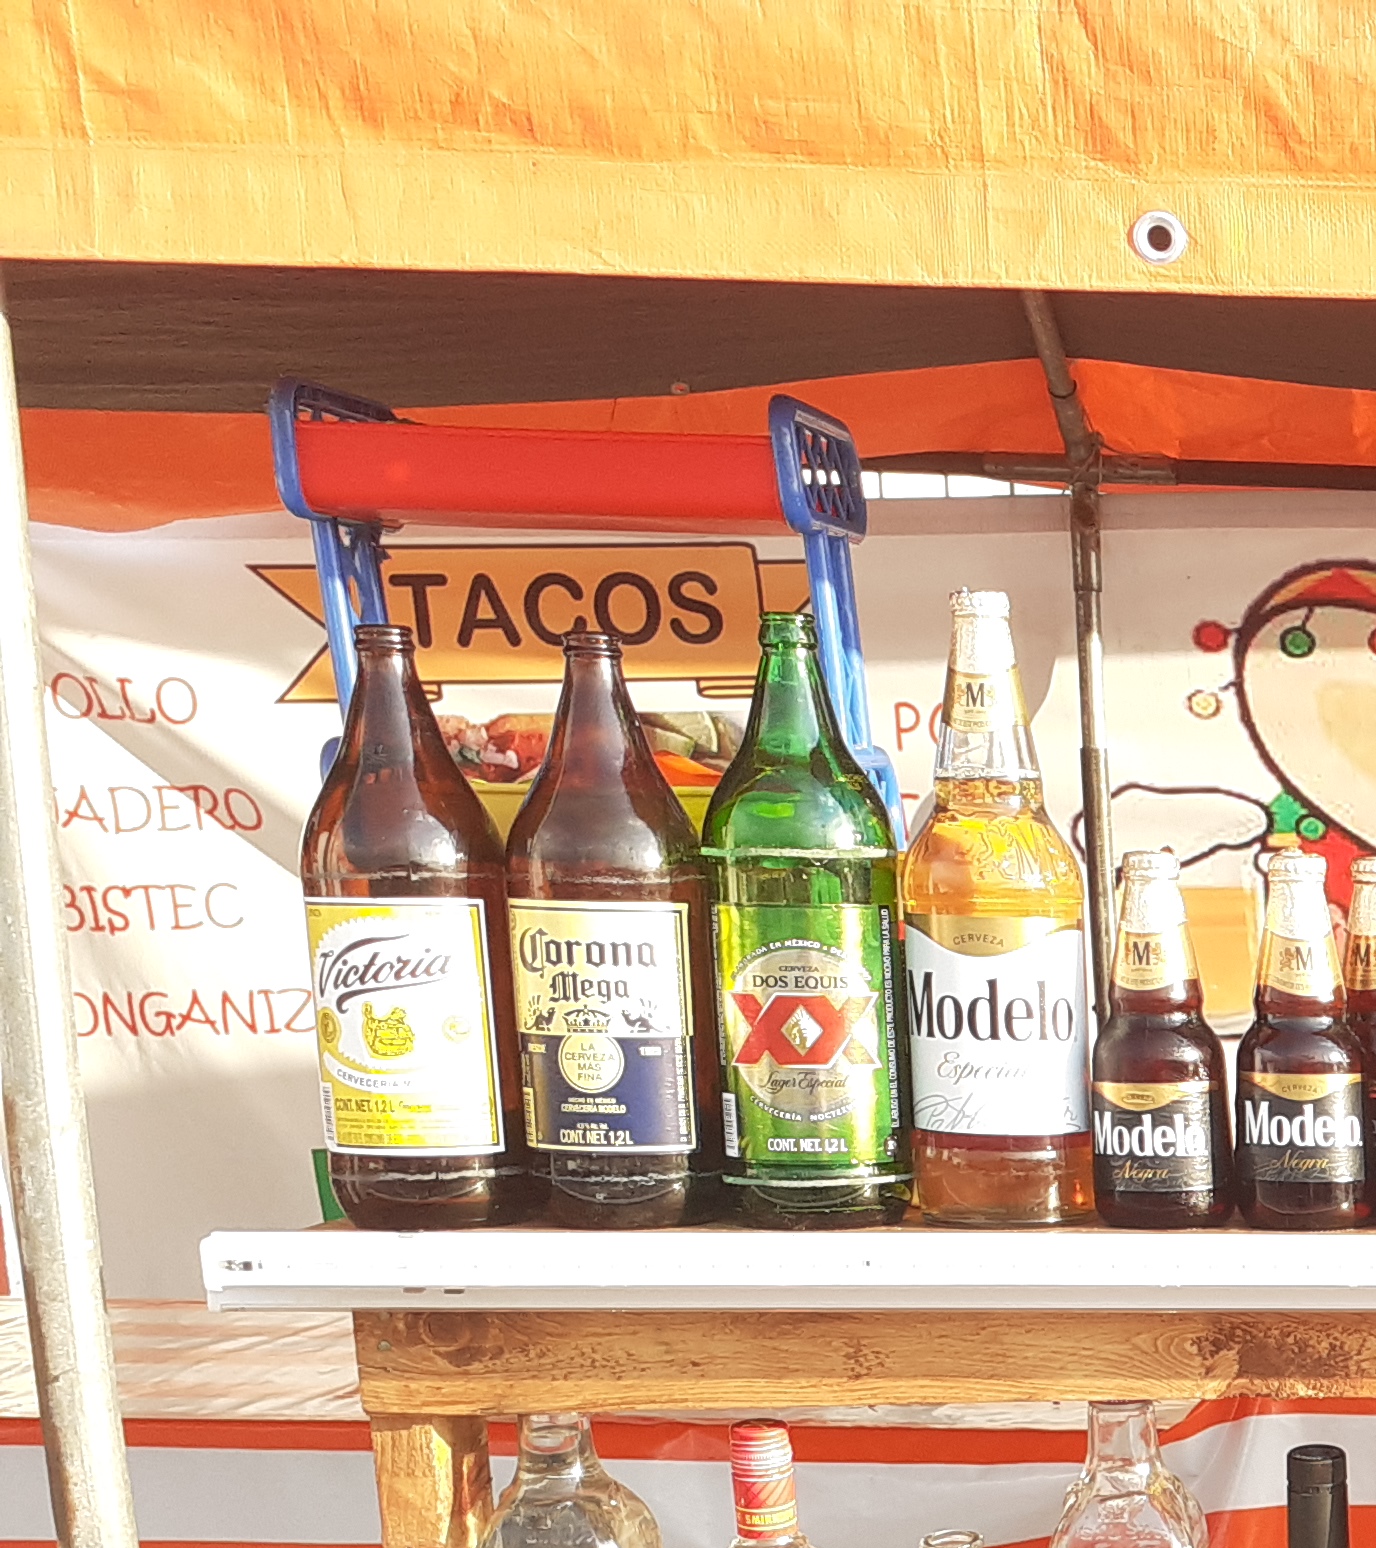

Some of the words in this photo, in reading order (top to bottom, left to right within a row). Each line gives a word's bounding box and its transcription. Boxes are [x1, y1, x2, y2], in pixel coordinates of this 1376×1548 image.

[388, 570, 725, 648] TACOS
[50, 672, 197, 724] OLLO
[966, 682, 985, 708] M
[54, 784, 263, 834] ADERO
[518, 926, 658, 980] Corona
[952, 933, 1005, 948] CERVEZA
[316, 934, 452, 1014] Victoria
[549, 970, 630, 1005] Mega
[752, 974, 789, 990] DOS
[794, 974, 848, 991] EQUIS
[74, 987, 316, 1038] ONGANIZ
[907, 969, 1075, 1042] Modelo
[564, 1052, 616, 1061] CERVEZA
[580, 1043, 596, 1052] LA
[577, 1073, 603, 1082] FINA
[1094, 1110, 1208, 1157] Modelo
[1244, 1100, 1363, 1149] Modelo
[1269, 1150, 1334, 1171] Negra
